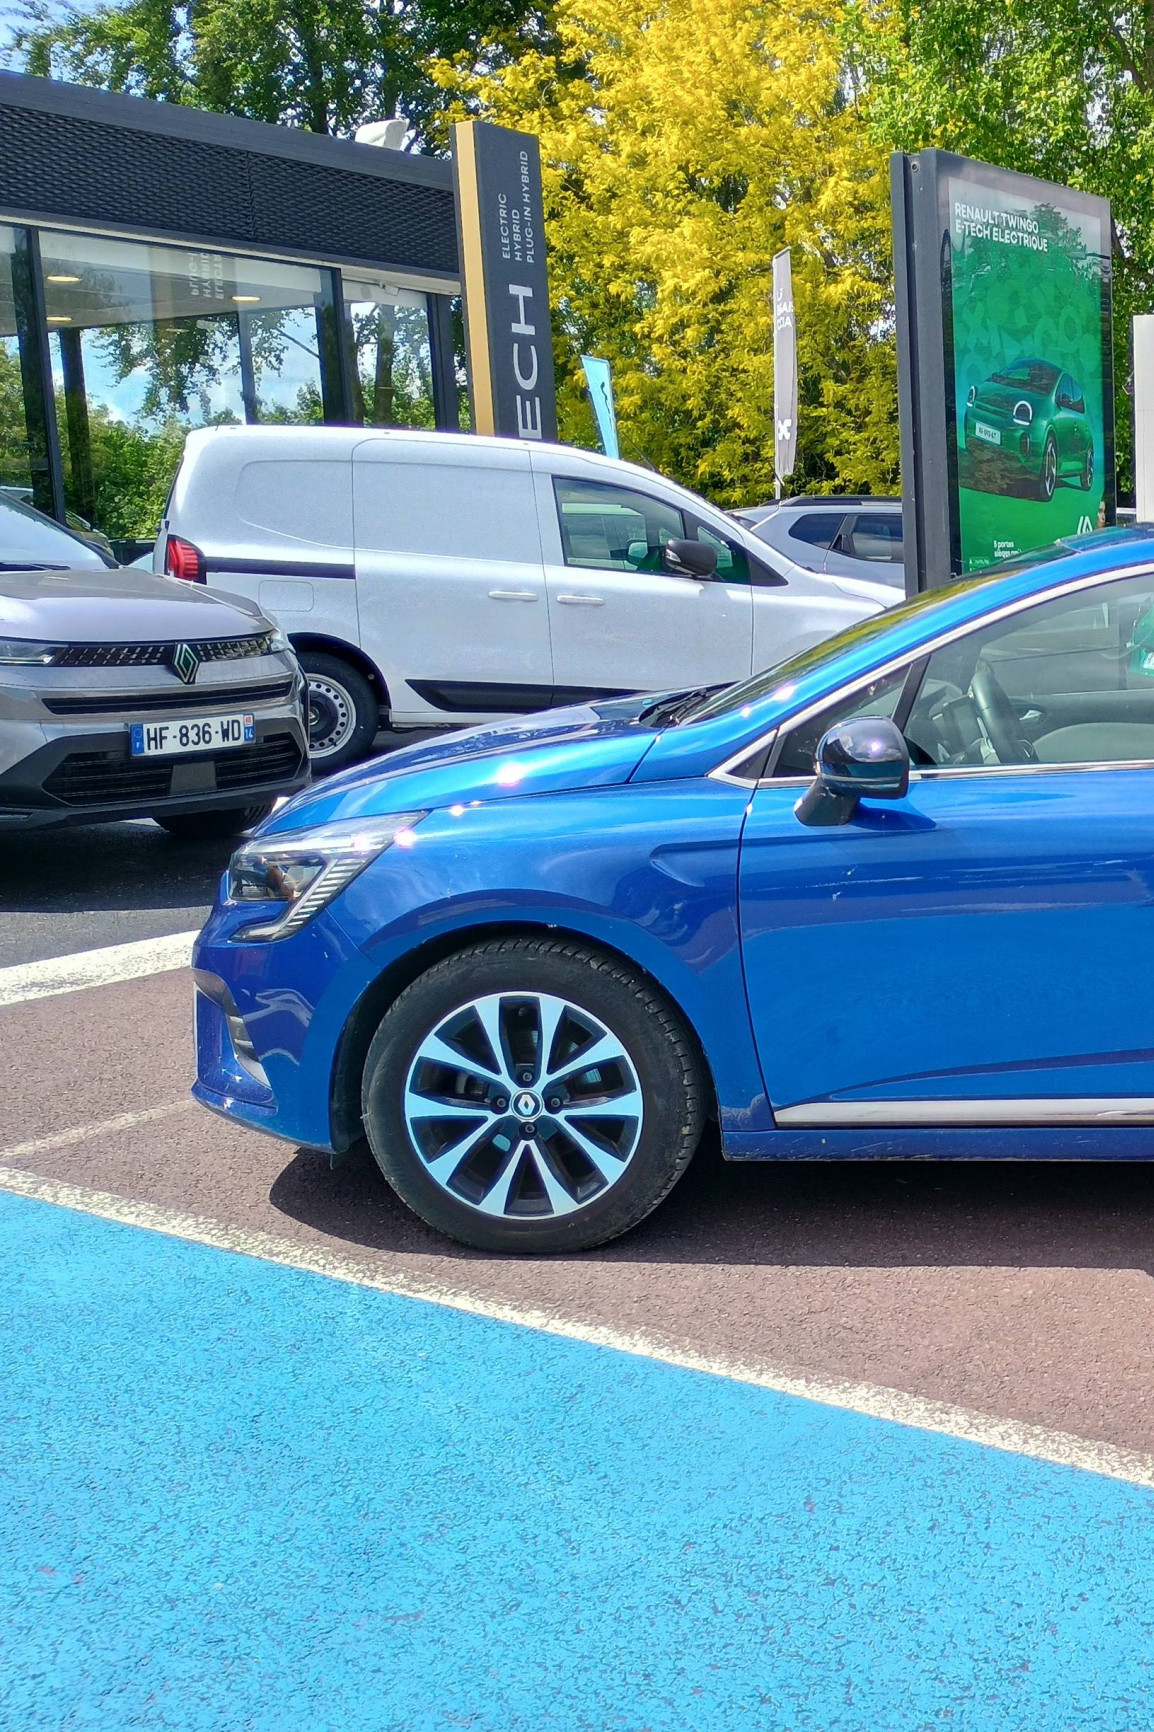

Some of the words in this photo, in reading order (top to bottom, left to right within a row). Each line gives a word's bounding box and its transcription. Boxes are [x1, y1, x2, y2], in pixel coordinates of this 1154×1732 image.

[520, 150, 531, 203] HYBRID
[498, 193, 511, 259] ELECTRIC
[512, 209, 523, 261] HYBRID
[523, 206, 535, 263] PLUG-IN
[955, 202, 1000, 225] RENAULT
[1001, 212, 1039, 234] TWINGO
[955, 219, 991, 240] E-TECH
[992, 226, 1048, 252] ELECTRIQUE
[508, 283, 543, 440] ECH
[146, 718, 242, 751] HF-836-WD
[244, 727, 254, 739] 14
